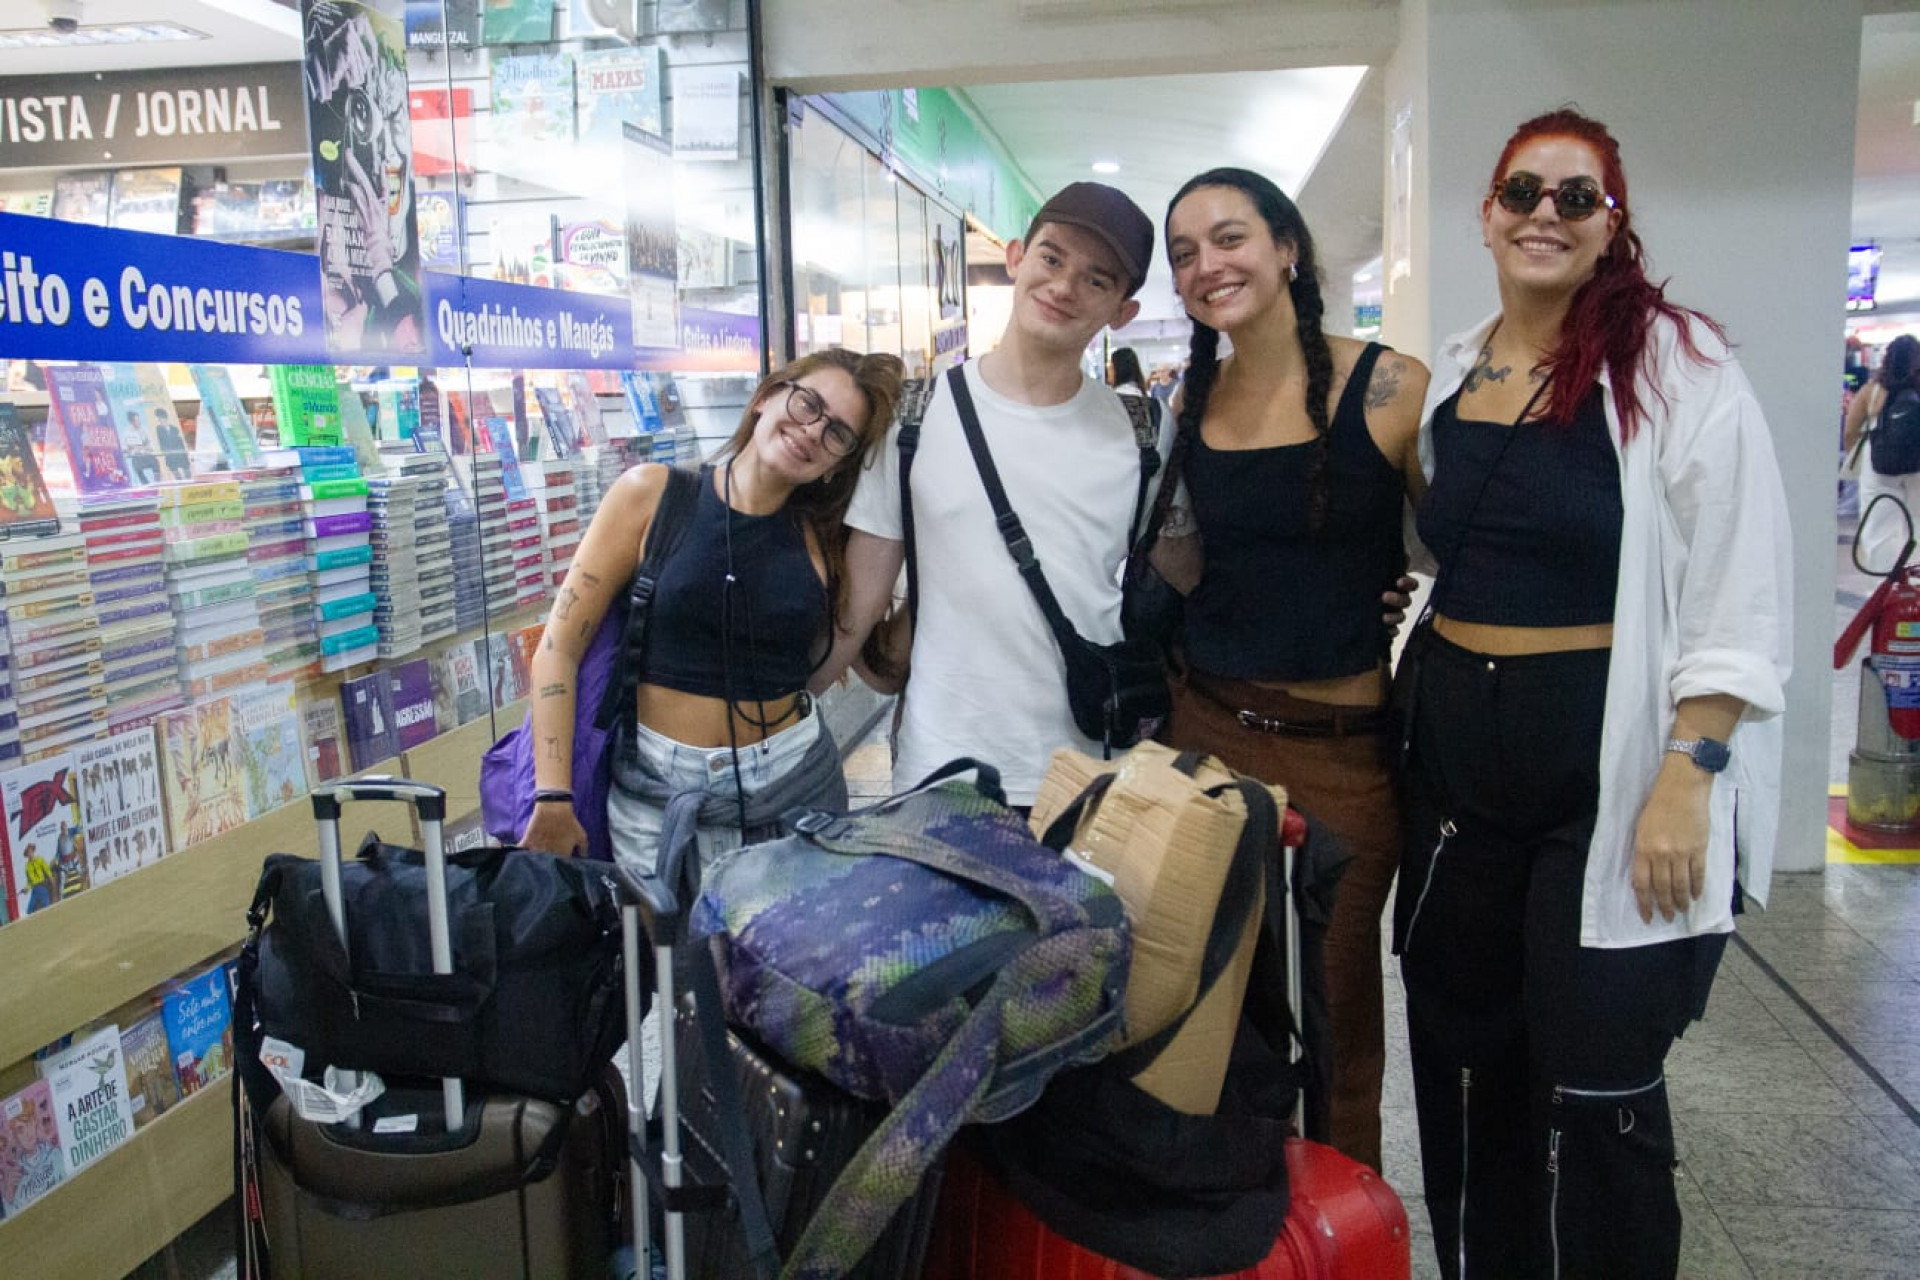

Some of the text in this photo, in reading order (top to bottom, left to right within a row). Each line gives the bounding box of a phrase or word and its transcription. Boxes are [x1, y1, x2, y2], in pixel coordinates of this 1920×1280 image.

[409, 31, 469, 44] MANGUZAL
[592, 69, 644, 90] MAPAS
[0, 96, 93, 142] ISTA
[135, 86, 281, 138] JORNAL
[83, 277, 110, 328] e
[119, 265, 303, 336] Concursos
[438, 299, 613, 359] Quadrinhos e Mangás
[67, 1079, 118, 1122] A ARTE DE
[73, 1102, 119, 1141] GASTAR
[70, 1119, 127, 1167] DINHEIRO
